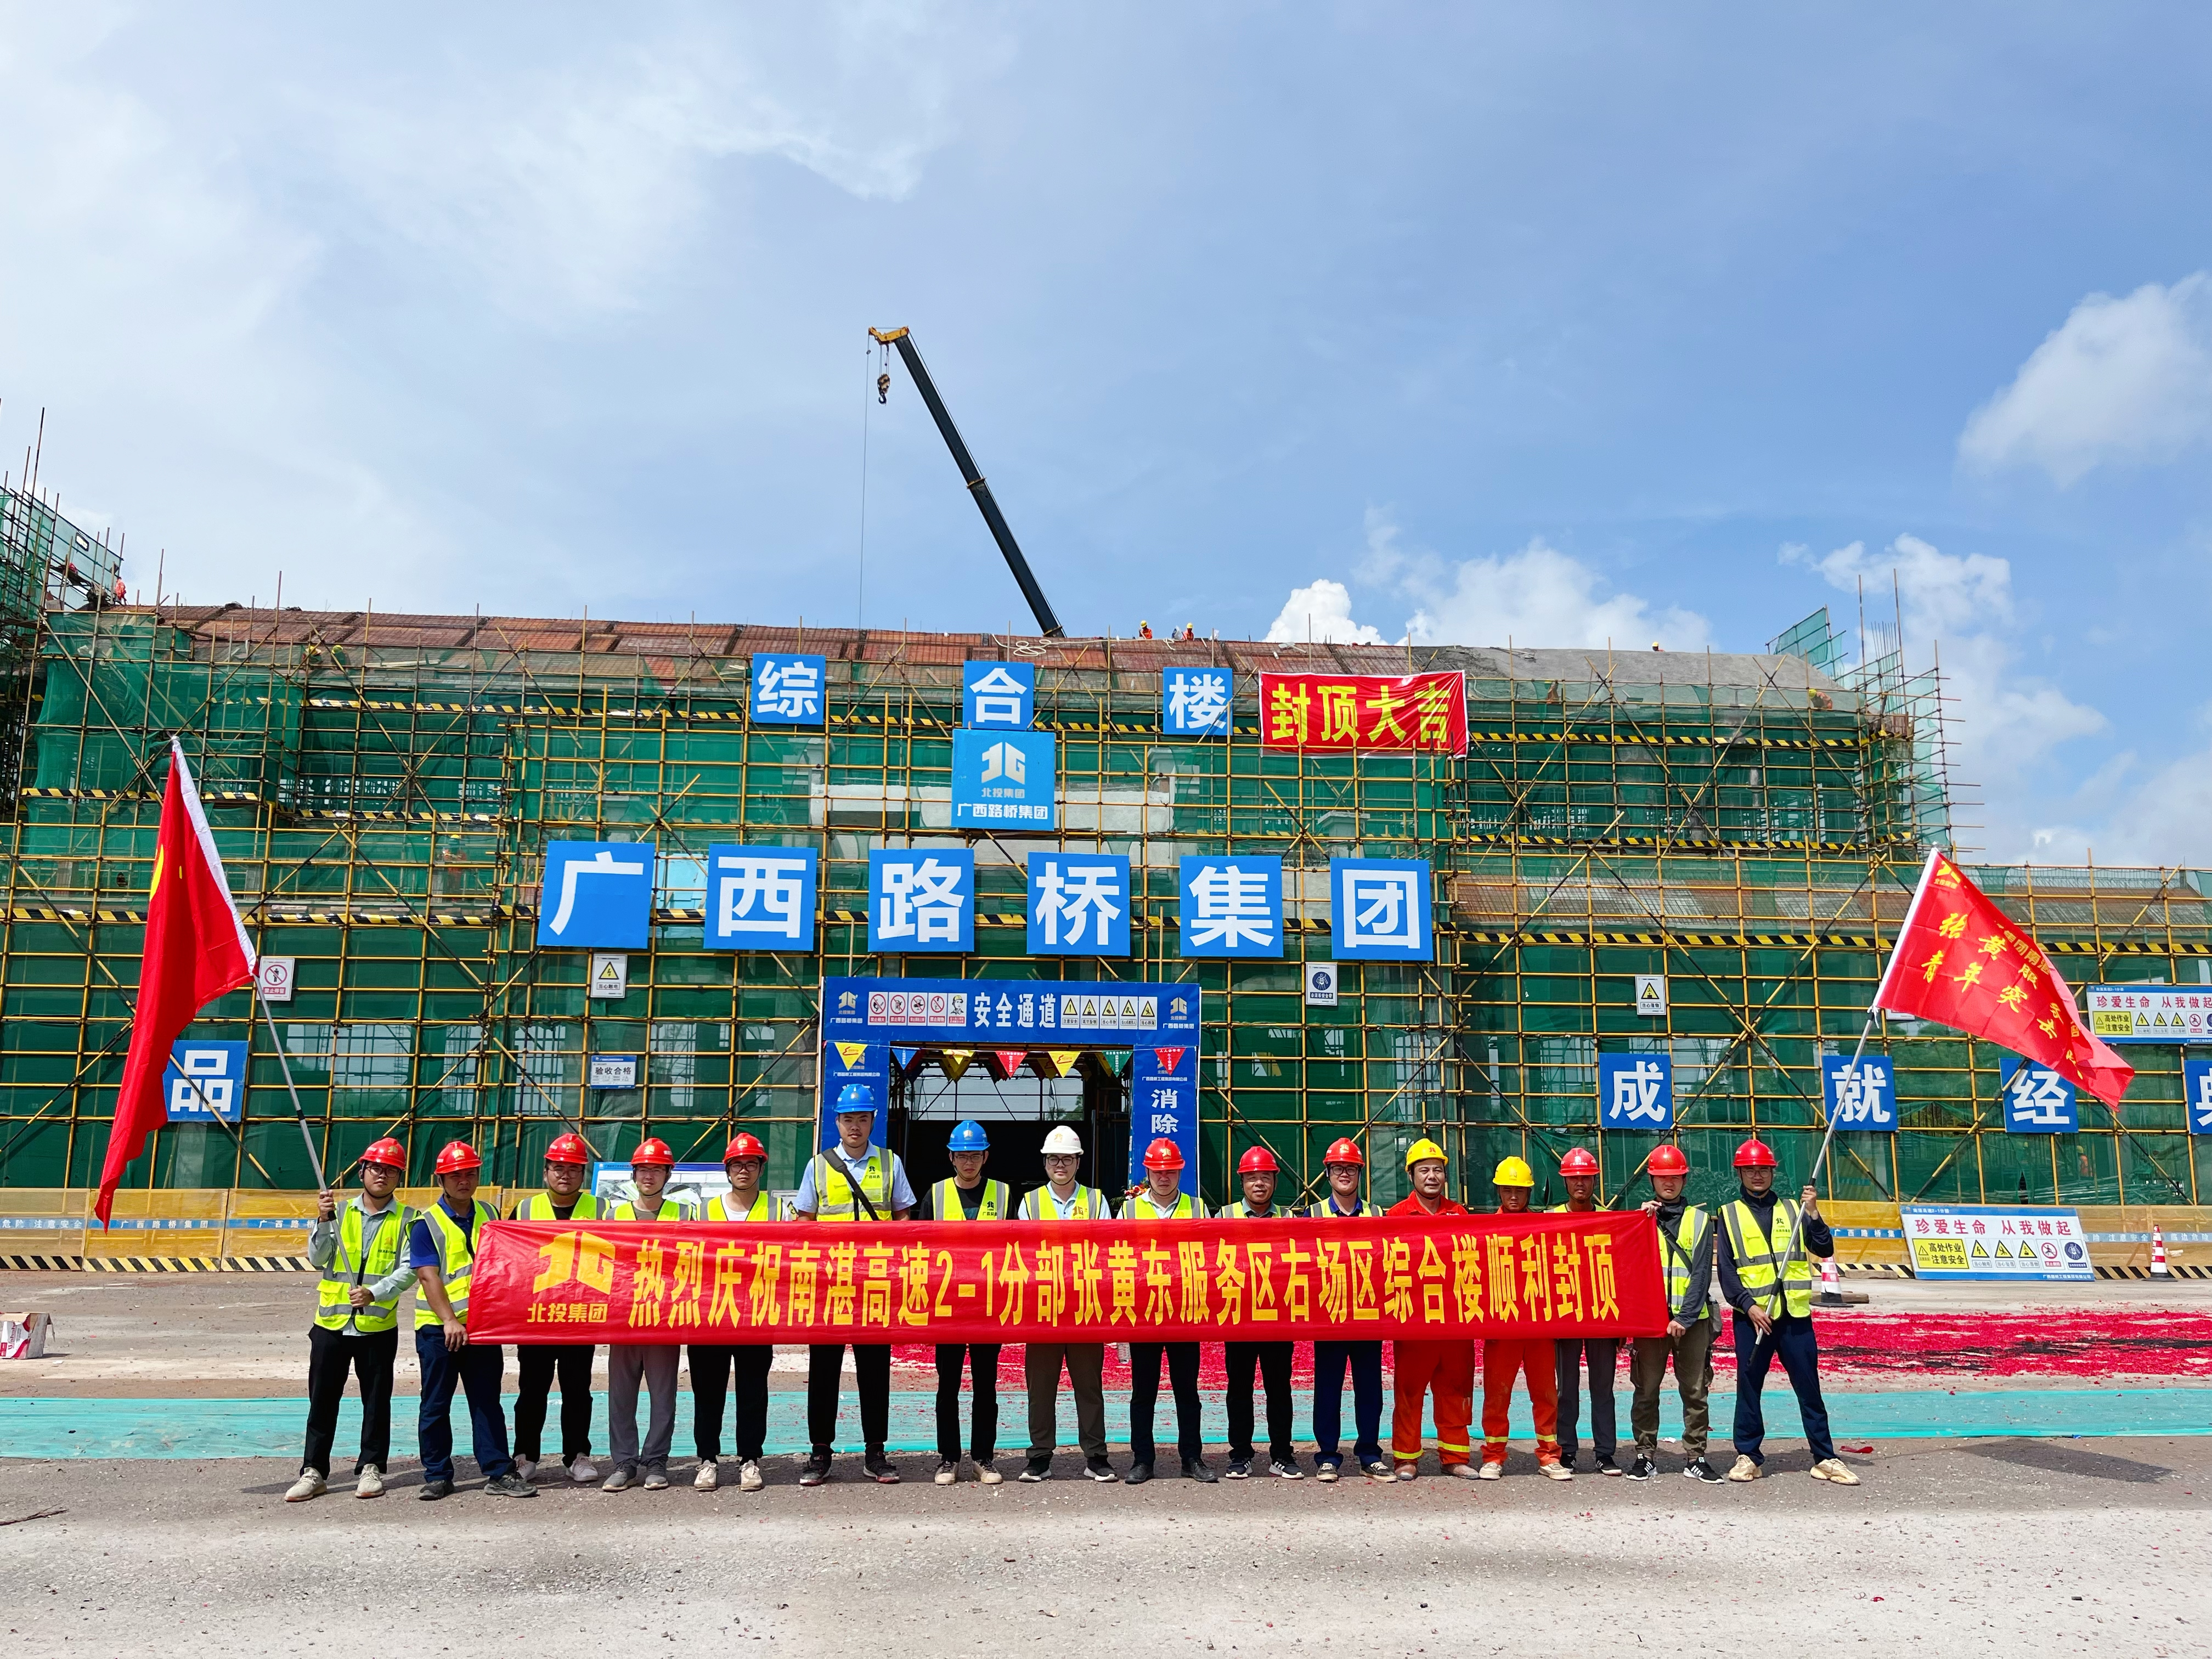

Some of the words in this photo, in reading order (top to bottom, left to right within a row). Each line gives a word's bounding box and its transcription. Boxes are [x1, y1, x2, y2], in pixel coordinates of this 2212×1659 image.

[1271, 681, 1451, 743] 封顶大吉
[981, 787, 1025, 799] 北投集团
[957, 803, 1048, 820] 广西路桥集团
[549, 851, 1420, 949] 广西路桥集团
[974, 992, 1057, 1028] 安全通道
[2096, 996, 2150, 1008] 珍爱生命
[2162, 996, 2212, 1008] 从我做起
[171, 1050, 234, 1111] 品
[1150, 1088, 1179, 1143] 消除
[2, 1219, 25, 1228] 危险
[34, 1219, 82, 1229] 注意安全
[120, 1220, 208, 1229] 广西路桥集团
[1915, 1218, 1986, 1235] 珍爱生命
[2001, 1219, 2072, 1236] 从我做起
[2108, 1233, 2148, 1242] 注意安全
[1928, 1243, 1962, 1252] 高处作业
[1931, 1255, 1965, 1265] 注意安全
[629, 1232, 1620, 1329] 热烈庆祝南湛高速2-1分部张黄东服务区右场区综合楼顺利封顶
[527, 1303, 607, 1323] 北投集团
